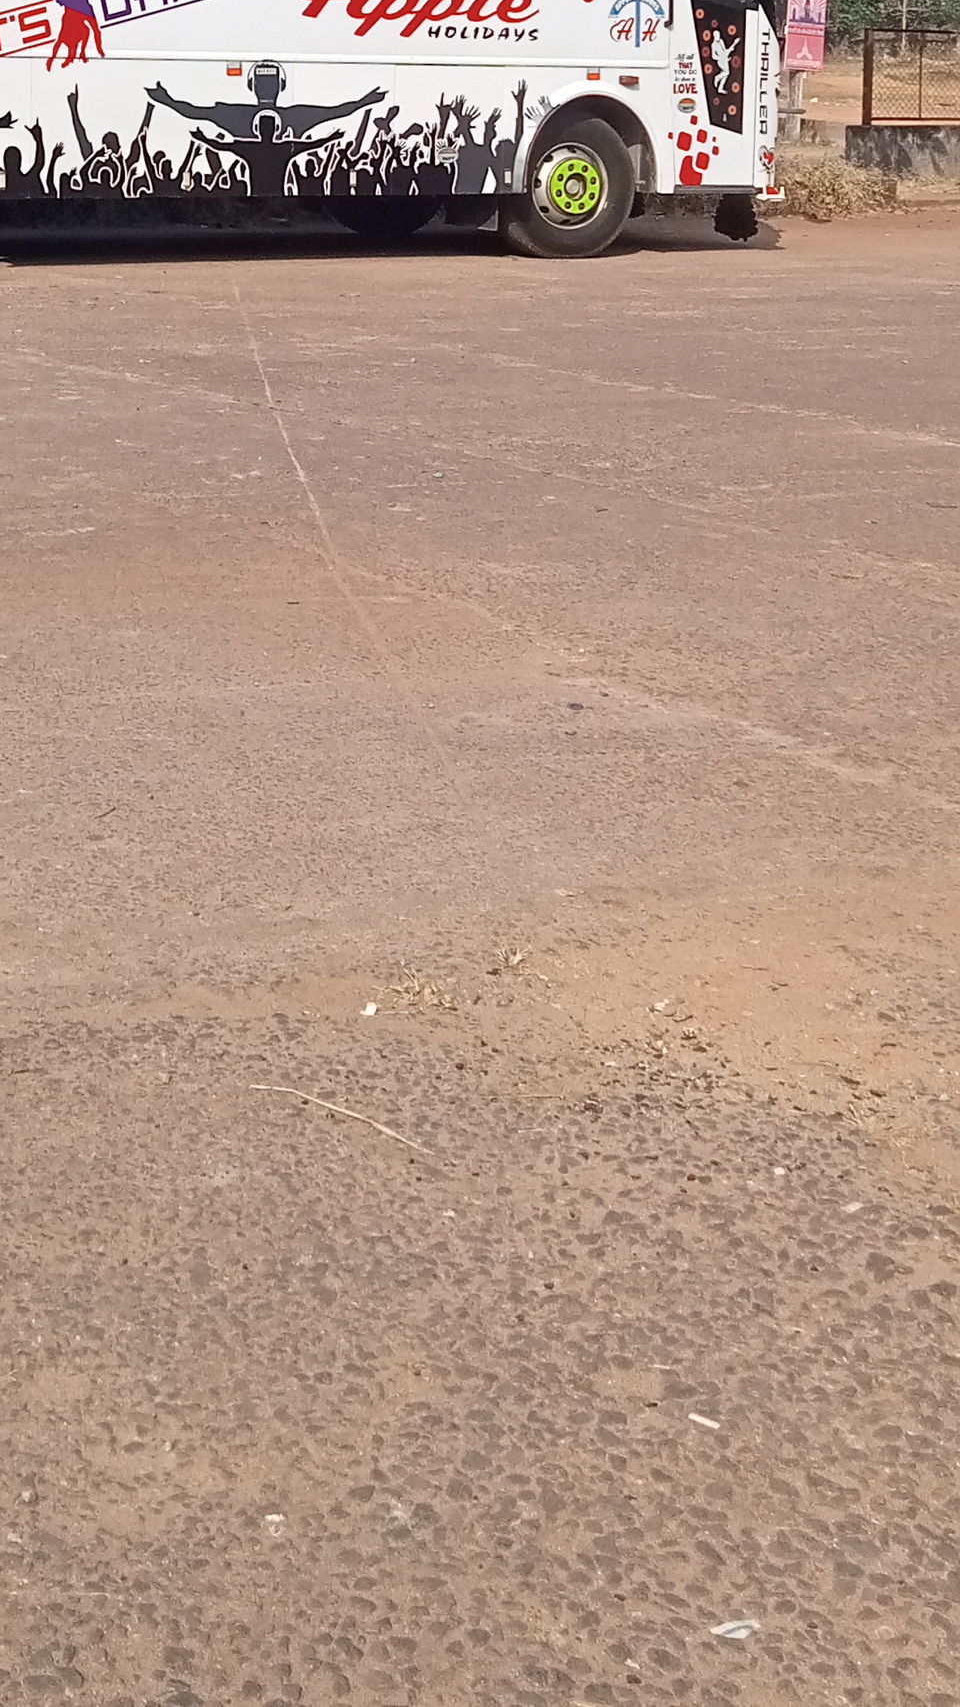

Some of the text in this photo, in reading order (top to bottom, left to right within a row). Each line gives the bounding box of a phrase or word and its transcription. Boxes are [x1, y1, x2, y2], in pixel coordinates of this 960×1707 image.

[428, 26, 540, 43] HOLIDAYS
[673, 83, 698, 94] LOVE
[759, 28, 771, 135] THRILLER
